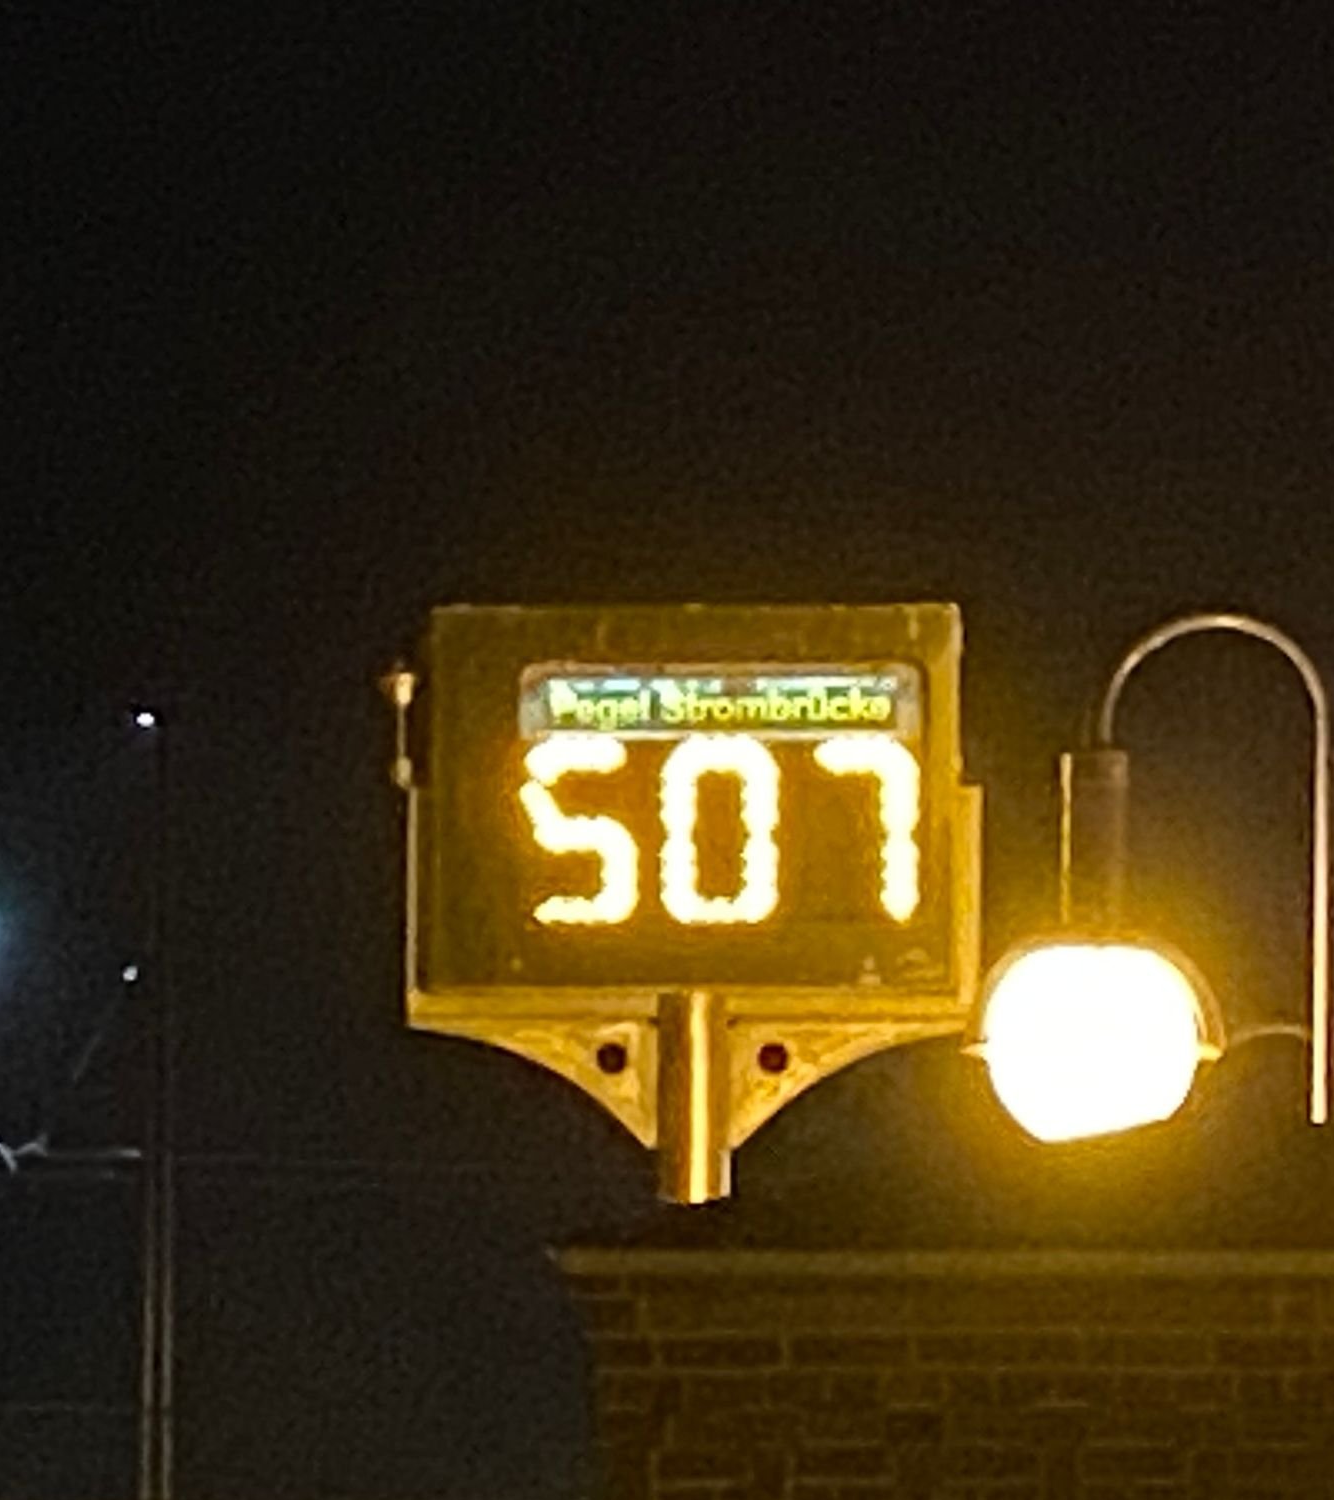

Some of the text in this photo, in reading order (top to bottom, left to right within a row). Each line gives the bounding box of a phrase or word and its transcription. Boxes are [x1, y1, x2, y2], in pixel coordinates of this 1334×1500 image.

[549, 682, 891, 729] Pegel Strombrücke
[521, 735, 921, 924] 507
